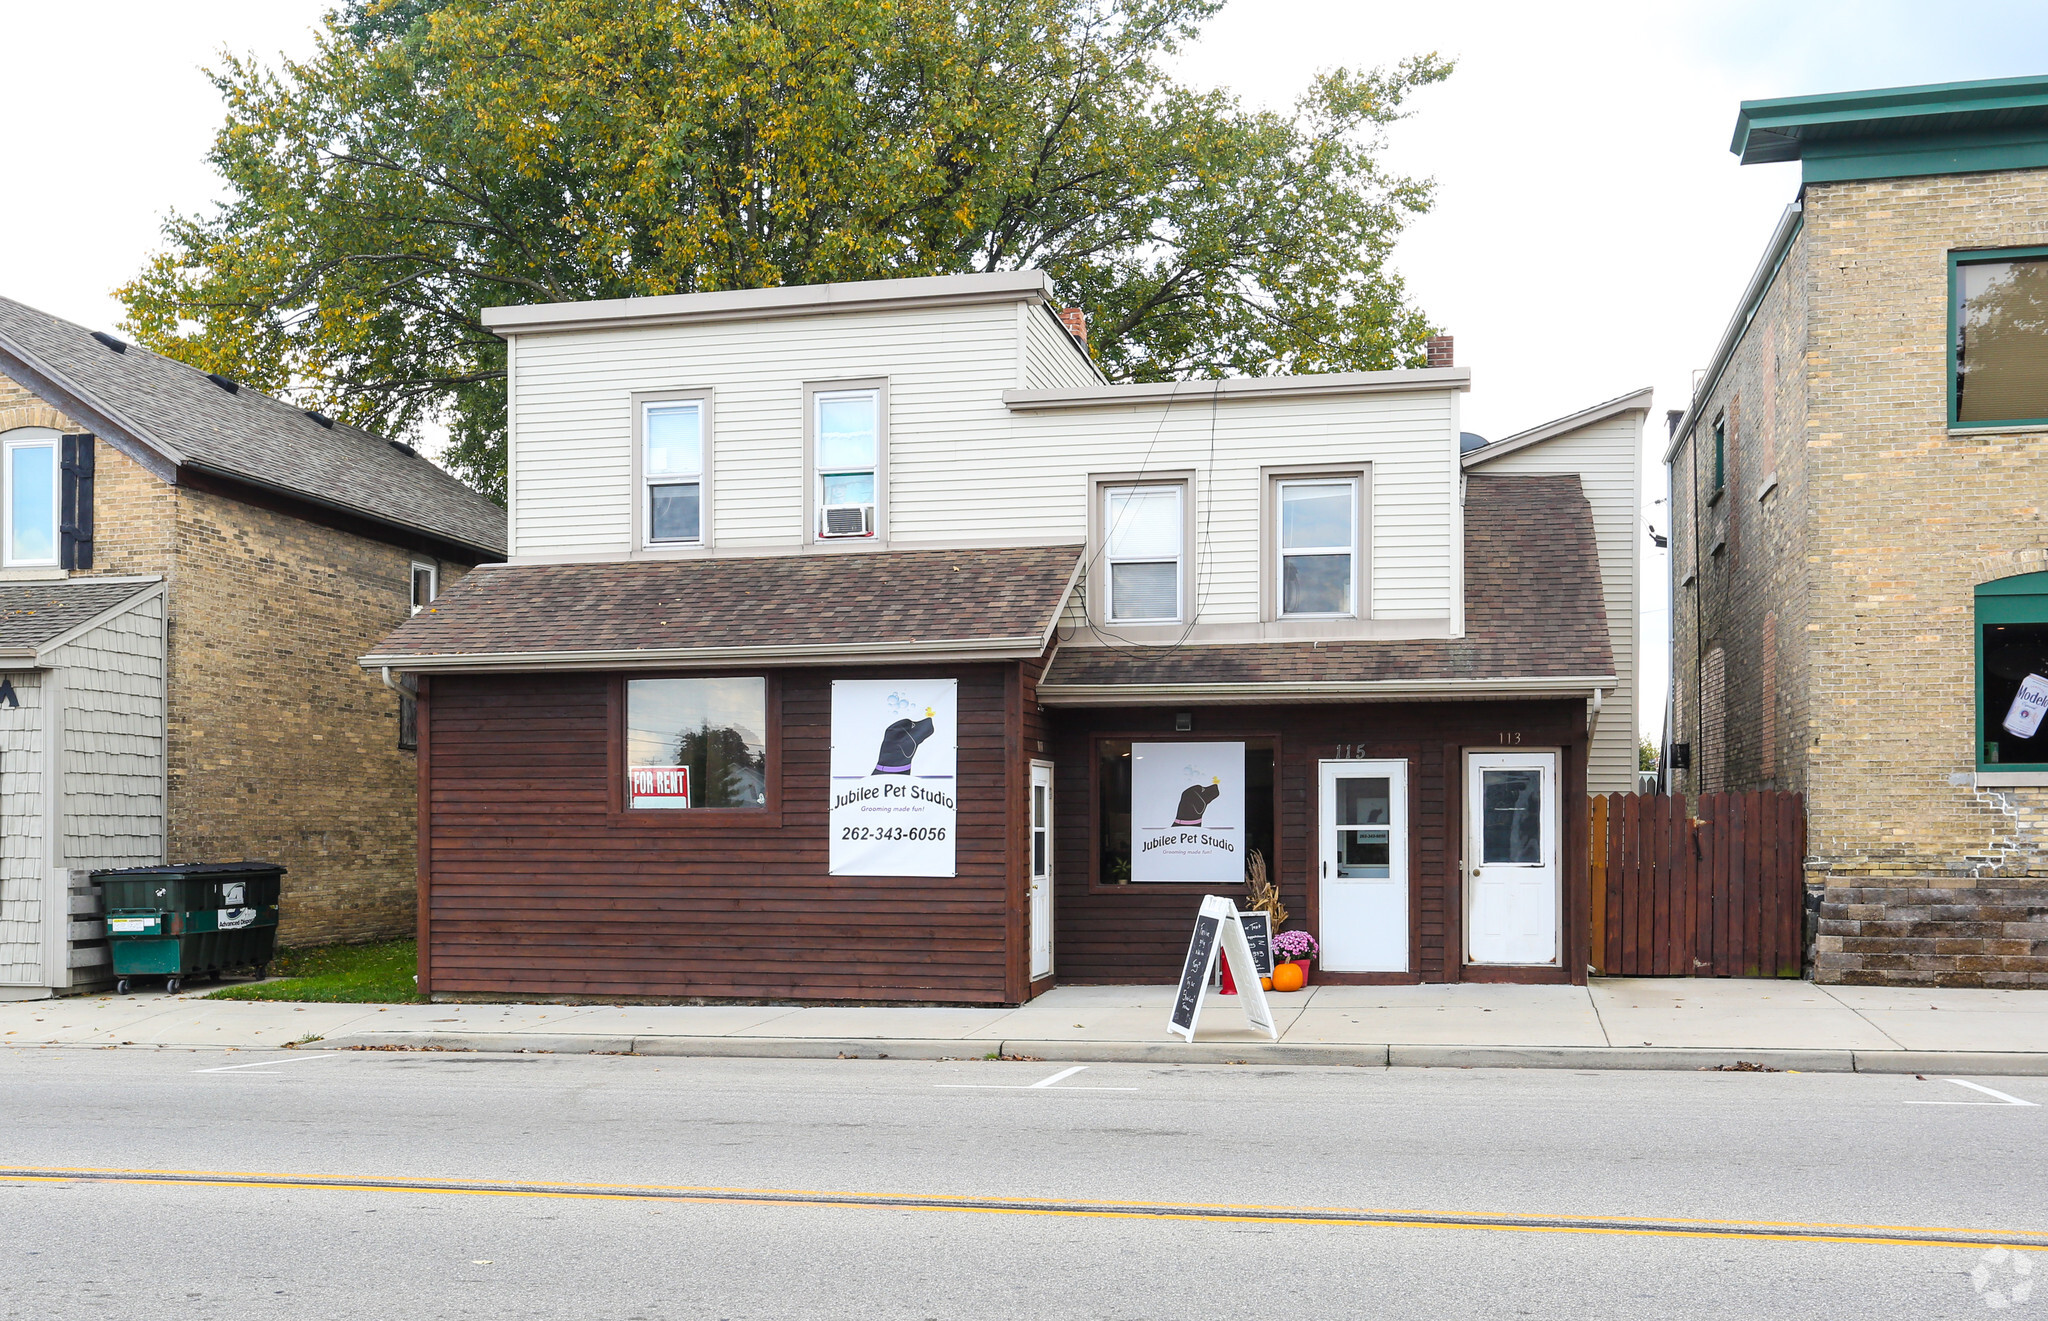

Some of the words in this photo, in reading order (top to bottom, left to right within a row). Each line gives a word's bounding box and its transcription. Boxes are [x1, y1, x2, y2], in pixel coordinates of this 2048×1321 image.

[1499, 732, 1521, 745] 113
[1335, 743, 1366, 759] 115
[634, 771, 653, 794] FOR
[656, 771, 685, 794] RENT
[834, 787, 880, 809] Jubilee
[884, 783, 907, 798] Pet
[910, 785, 954, 809] Studio
[860, 805, 892, 813] Grooming
[841, 826, 946, 841] 262-343-6056
[1142, 835, 1177, 852] Jubilee
[1180, 833, 1198, 844] Pet
[1200, 834, 1235, 852] Studio
